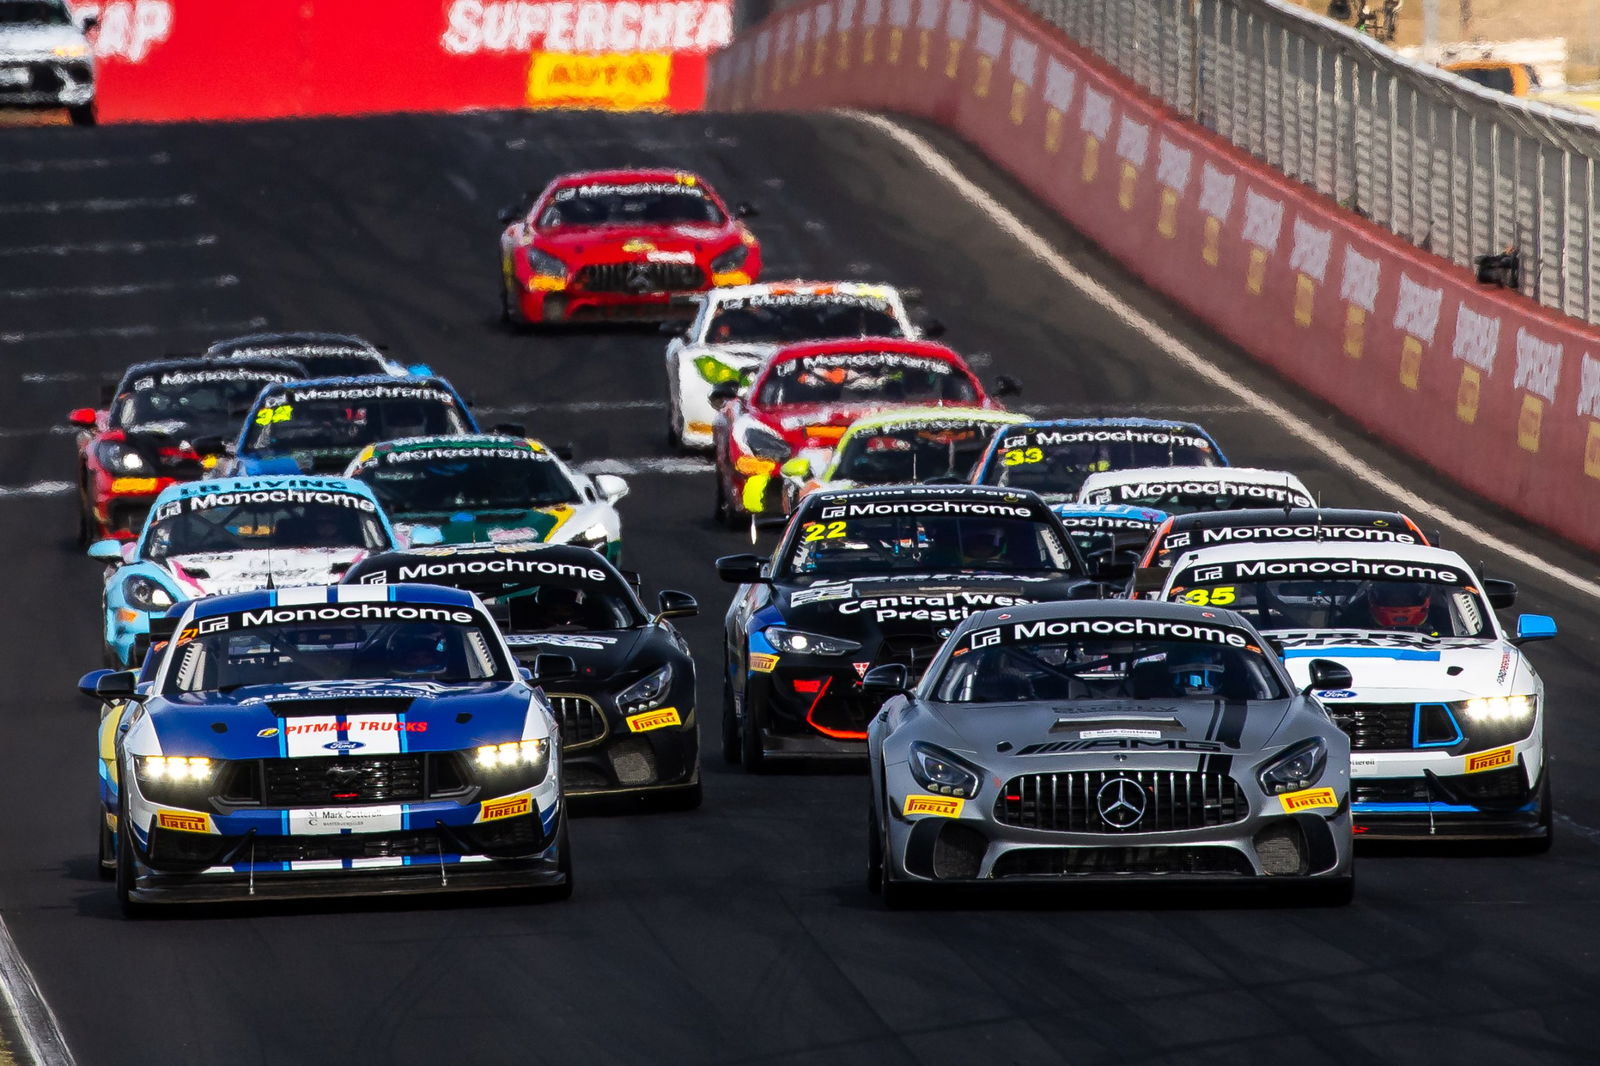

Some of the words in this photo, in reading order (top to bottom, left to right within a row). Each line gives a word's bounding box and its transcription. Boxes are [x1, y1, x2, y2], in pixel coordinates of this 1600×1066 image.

[1036, 430, 1208, 448] Monochrome
[1004, 447, 1043, 466] 33
[234, 479, 348, 490] LIVING
[1121, 481, 1311, 507] Monochrome
[191, 489, 376, 511] Monochrome
[850, 502, 1032, 517] Monochrome
[805, 521, 847, 542] 22
[1203, 525, 1415, 544] Monochrome
[400, 558, 606, 581] Monochrome
[1236, 560, 1458, 582] Monochrome
[839, 593, 954, 615] Central
[963, 592, 1038, 606] Wes
[1185, 587, 1235, 606] 35
[243, 604, 473, 627] Monochrome
[876, 606, 980, 623] Presti
[180, 628, 199, 640] 71
[1014, 619, 1247, 647] Monochrome
[1323, 690, 1349, 698] Ford
[285, 722, 352, 735] PITMAN
[359, 721, 428, 732] TRUCKS
[328, 740, 357, 750] Ford
[1469, 749, 1511, 771] PIRELLI
[483, 798, 528, 819] PIRELLI
[907, 799, 958, 814] PIRELLI
[1285, 791, 1333, 809] PIRELLI
[160, 813, 206, 831] PIRELLI
[322, 811, 343, 819] Mark
